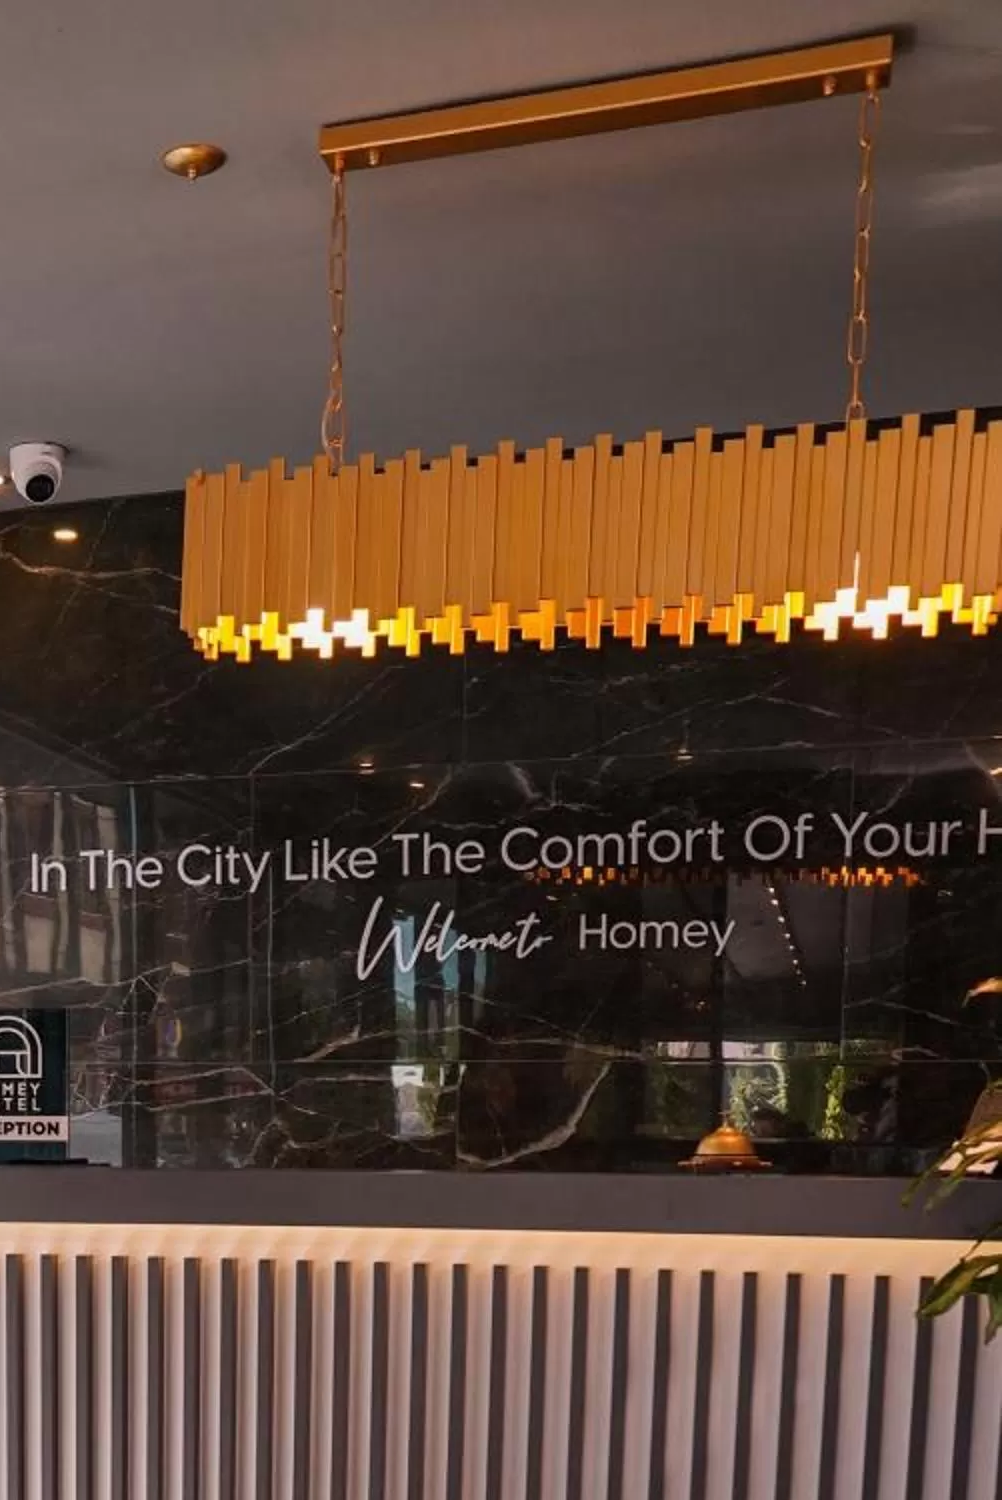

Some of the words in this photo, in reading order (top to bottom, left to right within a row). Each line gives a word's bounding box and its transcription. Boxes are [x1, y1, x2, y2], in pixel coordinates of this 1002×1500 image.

[30, 852, 68, 894] In
[78, 849, 164, 890] The
[177, 842, 270, 893] City
[284, 838, 378, 882] Like
[392, 832, 486, 877] The
[500, 819, 726, 870] Comfort
[744, 812, 814, 862] Of
[830, 810, 963, 858] Your
[977, 808, 1002, 856] H
[578, 913, 736, 957] Homey
